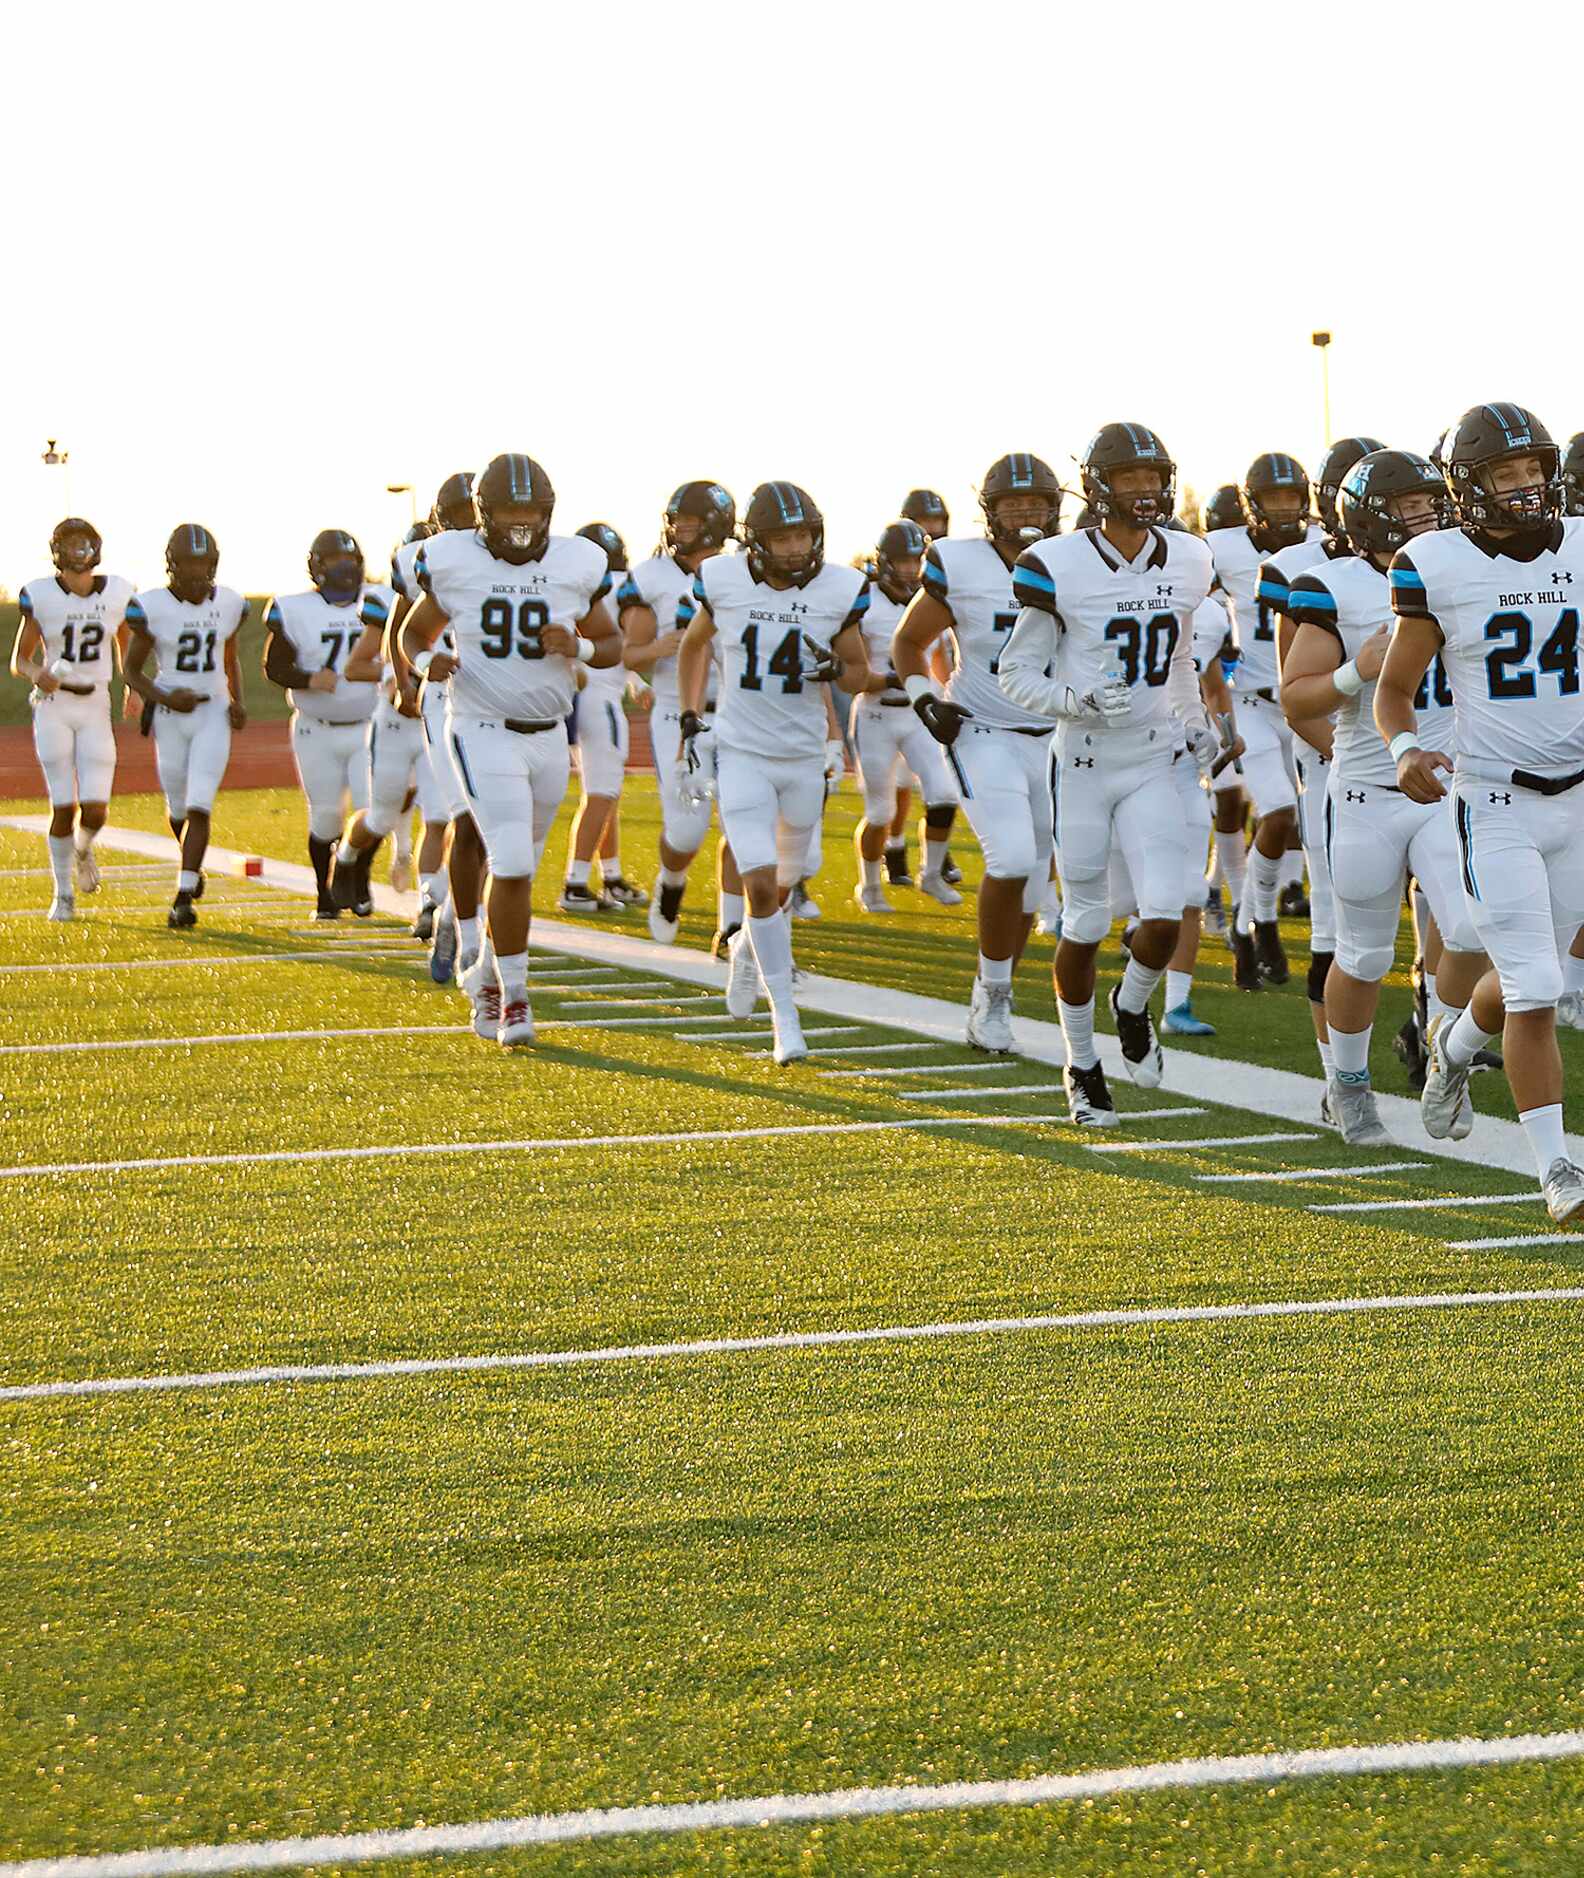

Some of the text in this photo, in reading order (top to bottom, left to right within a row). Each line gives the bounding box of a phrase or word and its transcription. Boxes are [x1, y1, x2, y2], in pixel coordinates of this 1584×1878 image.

[750, 610, 801, 624] ROCK HILL
[1117, 600, 1170, 613] ROCK HILL
[1499, 591, 1568, 607] ROCK HILL
[60, 623, 105, 663] 12
[480, 597, 550, 660] 99
[176, 630, 218, 672] 21
[739, 623, 804, 694] 14
[1104, 612, 1180, 688] 30
[1484, 608, 1581, 700] 24
